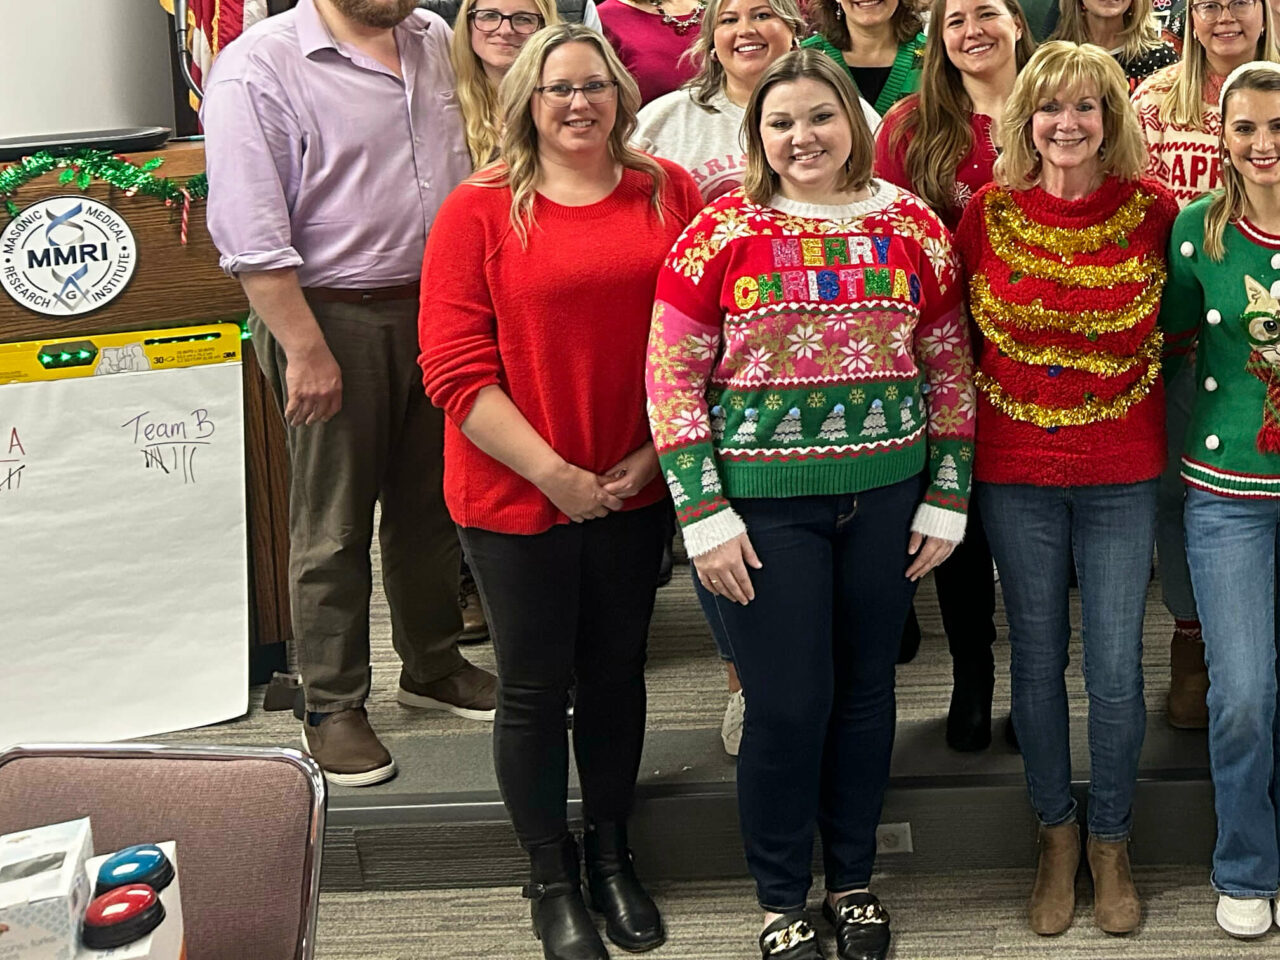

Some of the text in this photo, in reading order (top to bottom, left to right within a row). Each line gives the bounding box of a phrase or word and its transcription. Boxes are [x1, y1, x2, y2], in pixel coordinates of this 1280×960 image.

[3, 206, 127, 254] MASONIC MEDICAL
[27, 242, 108, 269] MMRI
[771, 235, 892, 268] MERRY
[4, 252, 130, 308] RESEARCH INSTITUTE
[65, 290, 77, 300] G
[734, 266, 921, 310] CHRISTMAS
[9, 426, 26, 455] A
[121, 408, 215, 444] Team B
